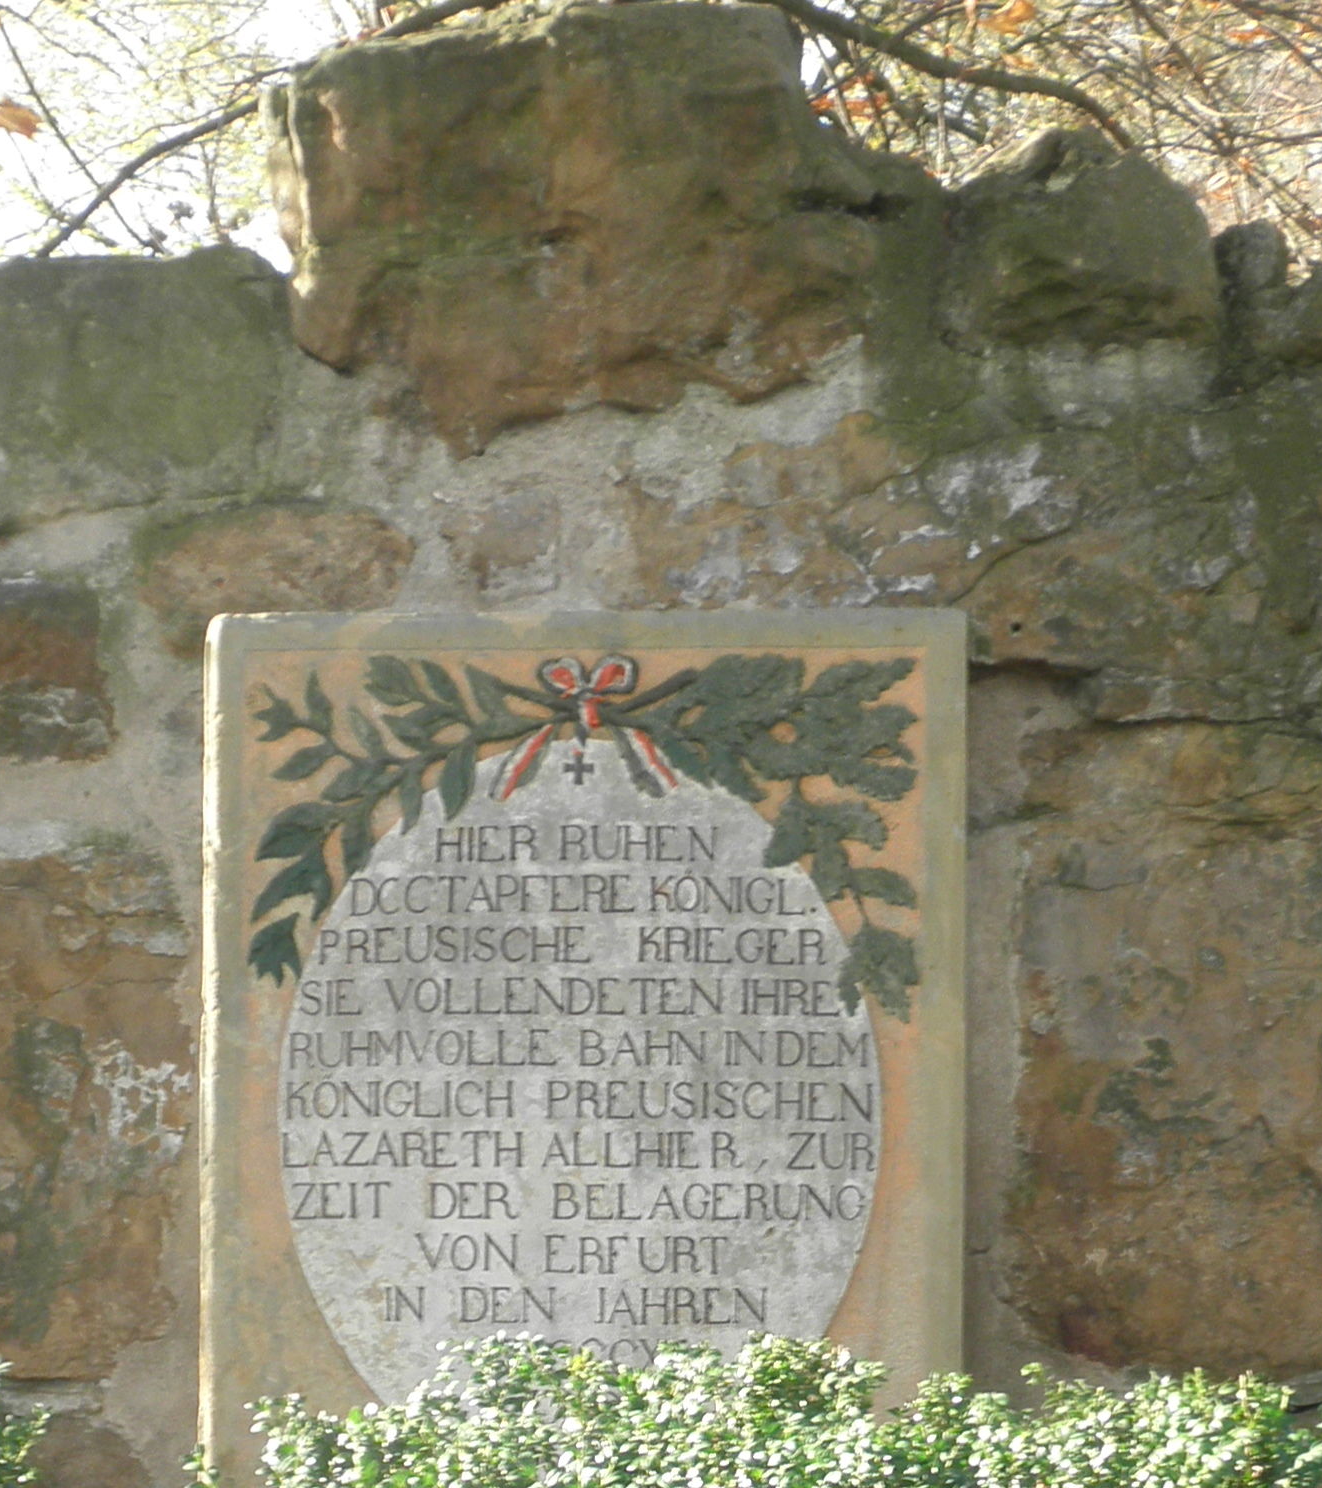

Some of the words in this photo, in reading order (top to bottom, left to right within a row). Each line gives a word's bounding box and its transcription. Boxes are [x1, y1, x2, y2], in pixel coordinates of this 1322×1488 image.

[436, 827, 538, 862] HIER
[558, 826, 718, 861] RUHEN
[647, 869, 817, 916] KÖNIGL.
[318, 926, 591, 965] PREUSISCHE
[637, 926, 826, 965] KRIEGER
[299, 979, 363, 1017] SIE
[385, 977, 723, 1016] VOLLENDETEN
[741, 979, 839, 1016] IHRE
[288, 1029, 557, 1069] RUHMVOLLE
[578, 1029, 707, 1068] BAHN
[285, 1074, 514, 1120] KÖNIGLICH
[546, 1079, 875, 1123] PREUSISCHEN
[282, 1131, 524, 1169] LAZARETH
[785, 1132, 875, 1172] ZUR
[291, 1182, 392, 1220] ZEIT
[428, 1182, 519, 1220] DER
[552, 1182, 868, 1222] BELAGERUNG
[415, 1232, 519, 1273] VON
[543, 1235, 729, 1275] ERFURT
[382, 1286, 425, 1323] IN
[460, 1285, 555, 1326] DEN
